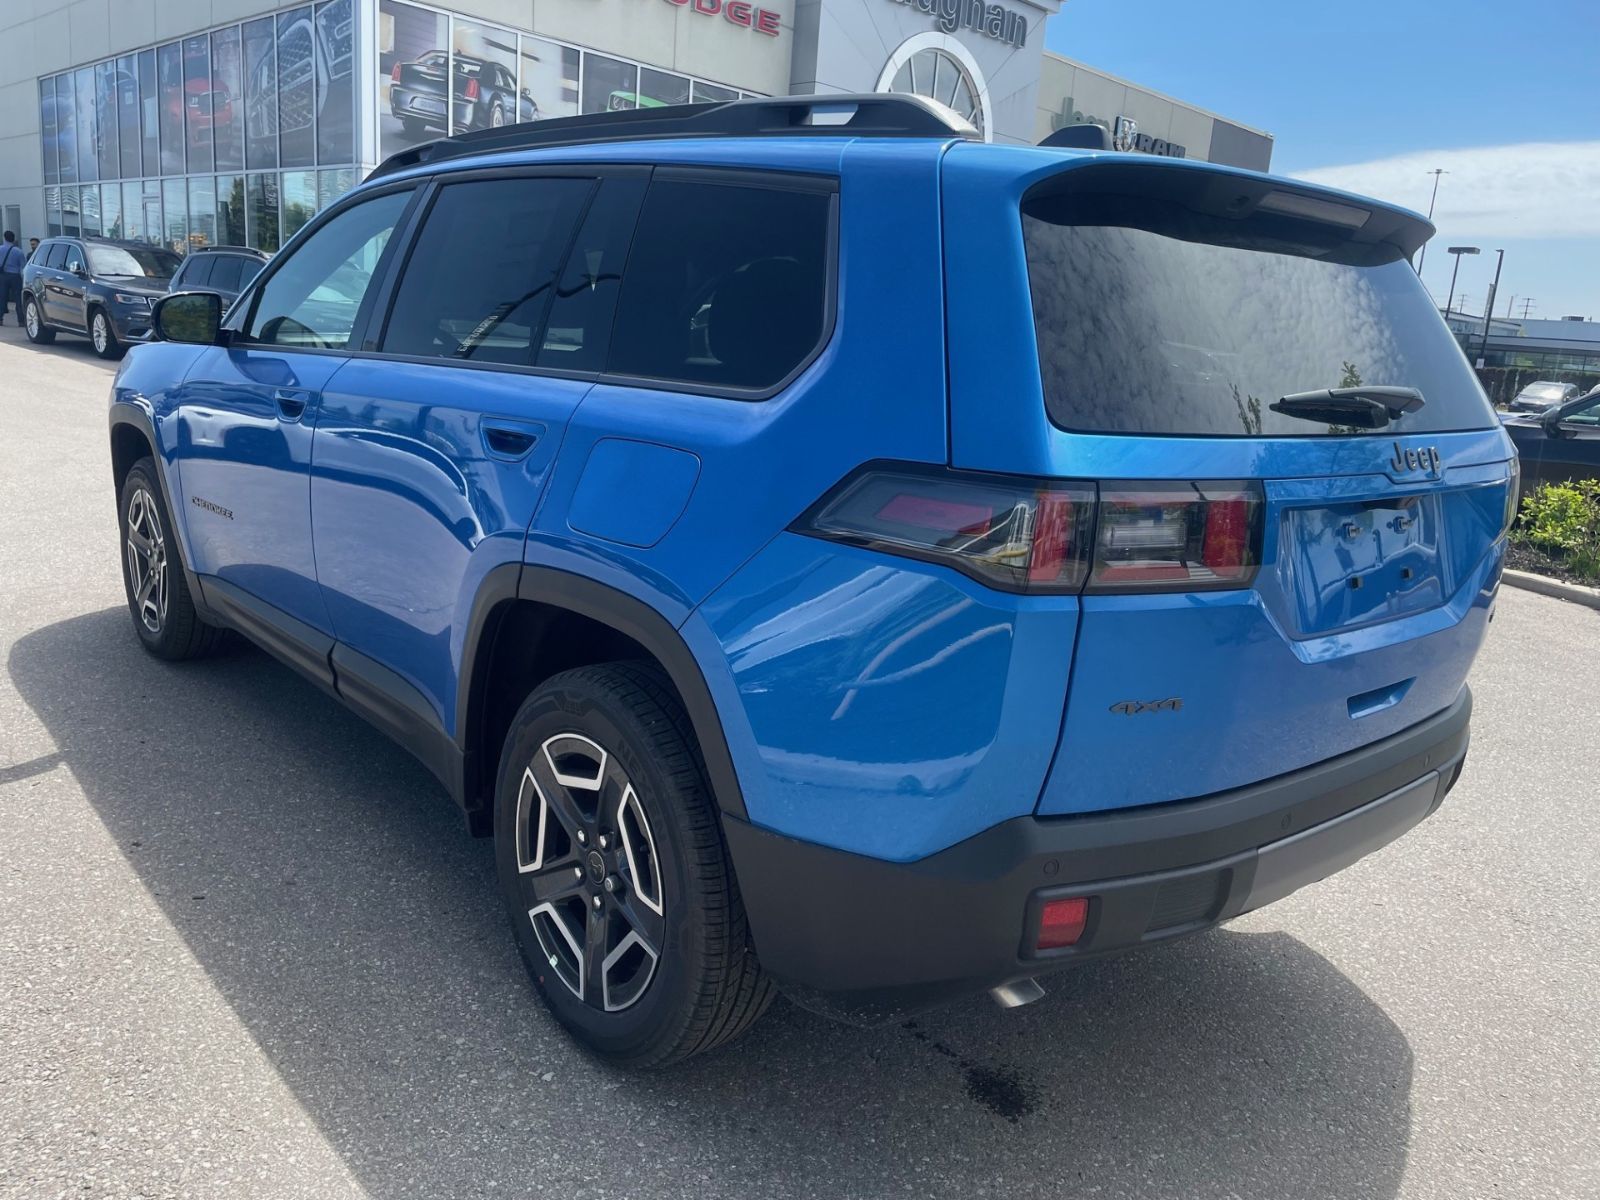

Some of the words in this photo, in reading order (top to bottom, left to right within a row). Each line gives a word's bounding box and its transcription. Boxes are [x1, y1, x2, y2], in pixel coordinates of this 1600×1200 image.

[663, 0, 781, 37] DGE
[1391, 441, 1440, 480] Jeep
[192, 496, 234, 520] CHEROKEE
